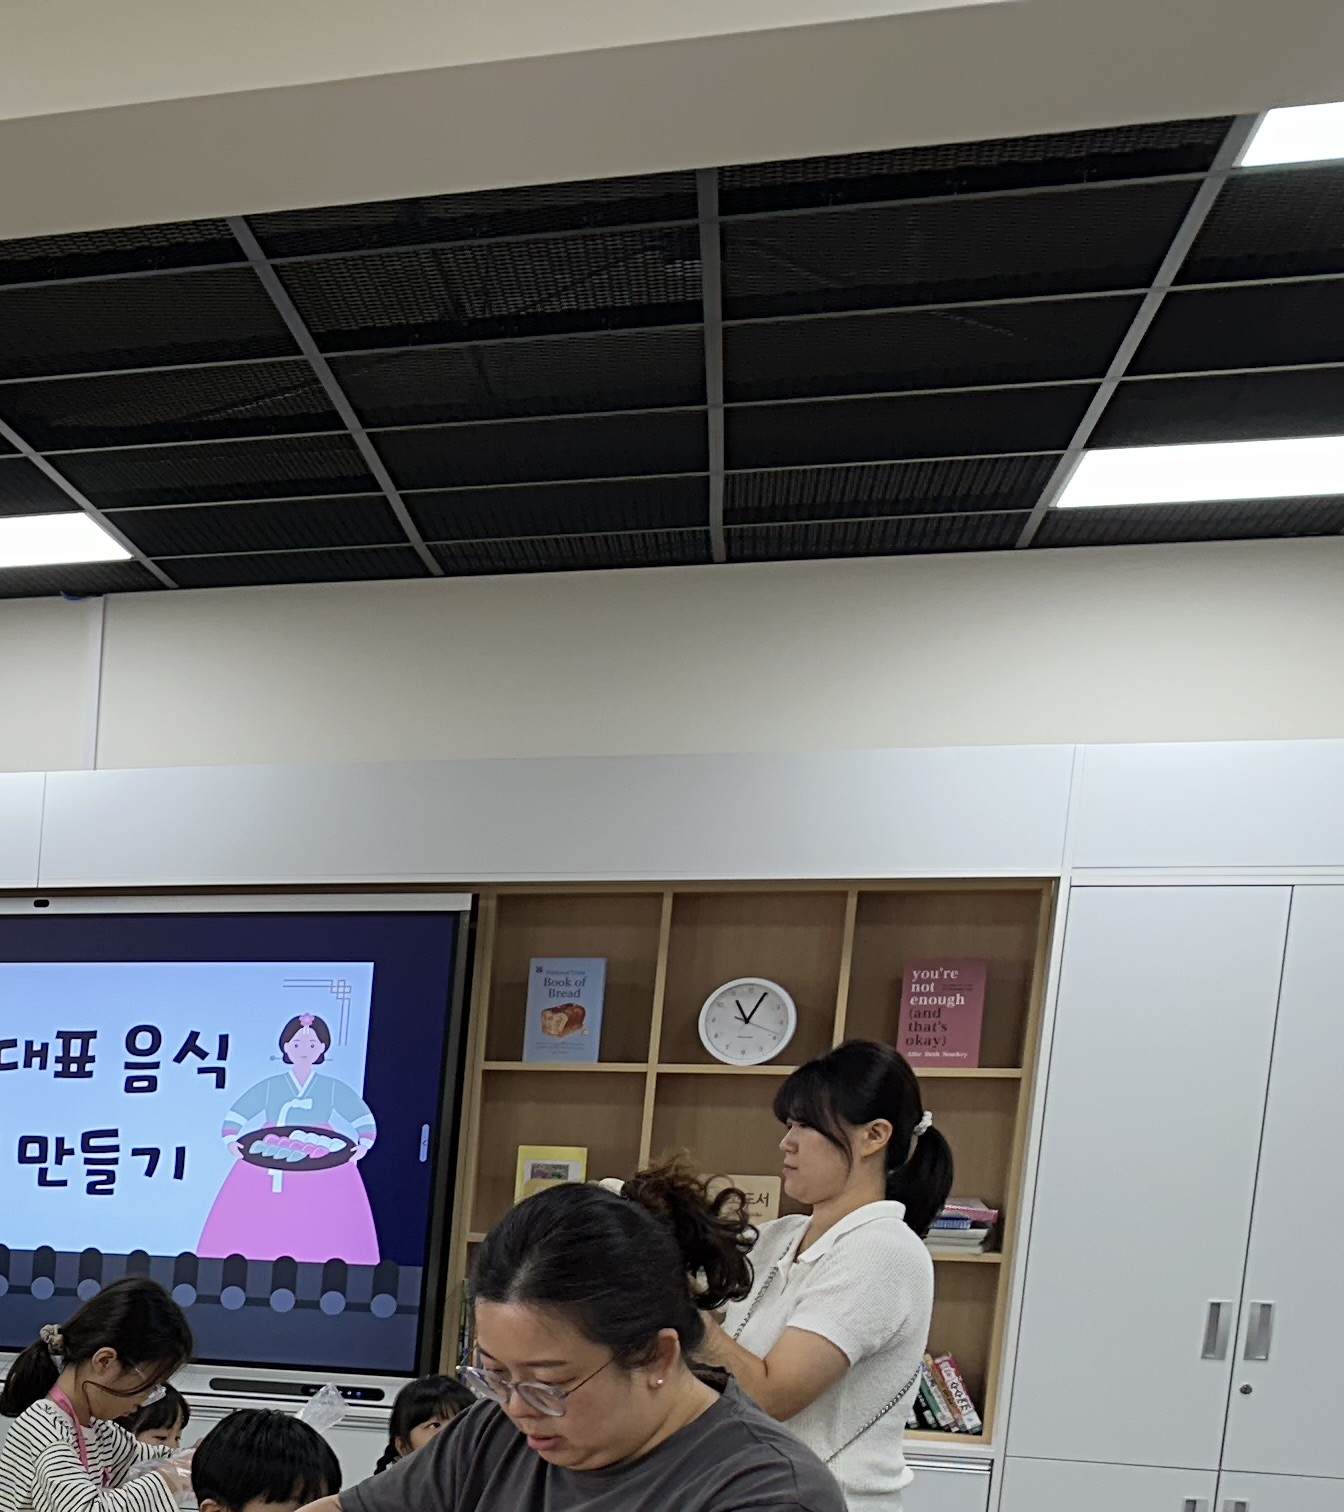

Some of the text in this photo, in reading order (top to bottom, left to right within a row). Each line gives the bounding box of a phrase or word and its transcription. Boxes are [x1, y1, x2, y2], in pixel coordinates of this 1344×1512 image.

[912, 967, 959, 982] you're
[543, 976, 588, 988] Book of
[911, 982, 935, 993] not
[548, 988, 581, 998] Bread
[909, 993, 965, 1008] enough
[909, 1007, 941, 1019] (and
[908, 1021, 947, 1032] that's
[905, 1034, 947, 1049] okay)
[123, 1023, 230, 1094] 음식
[16, 1127, 187, 1196] 만들기
